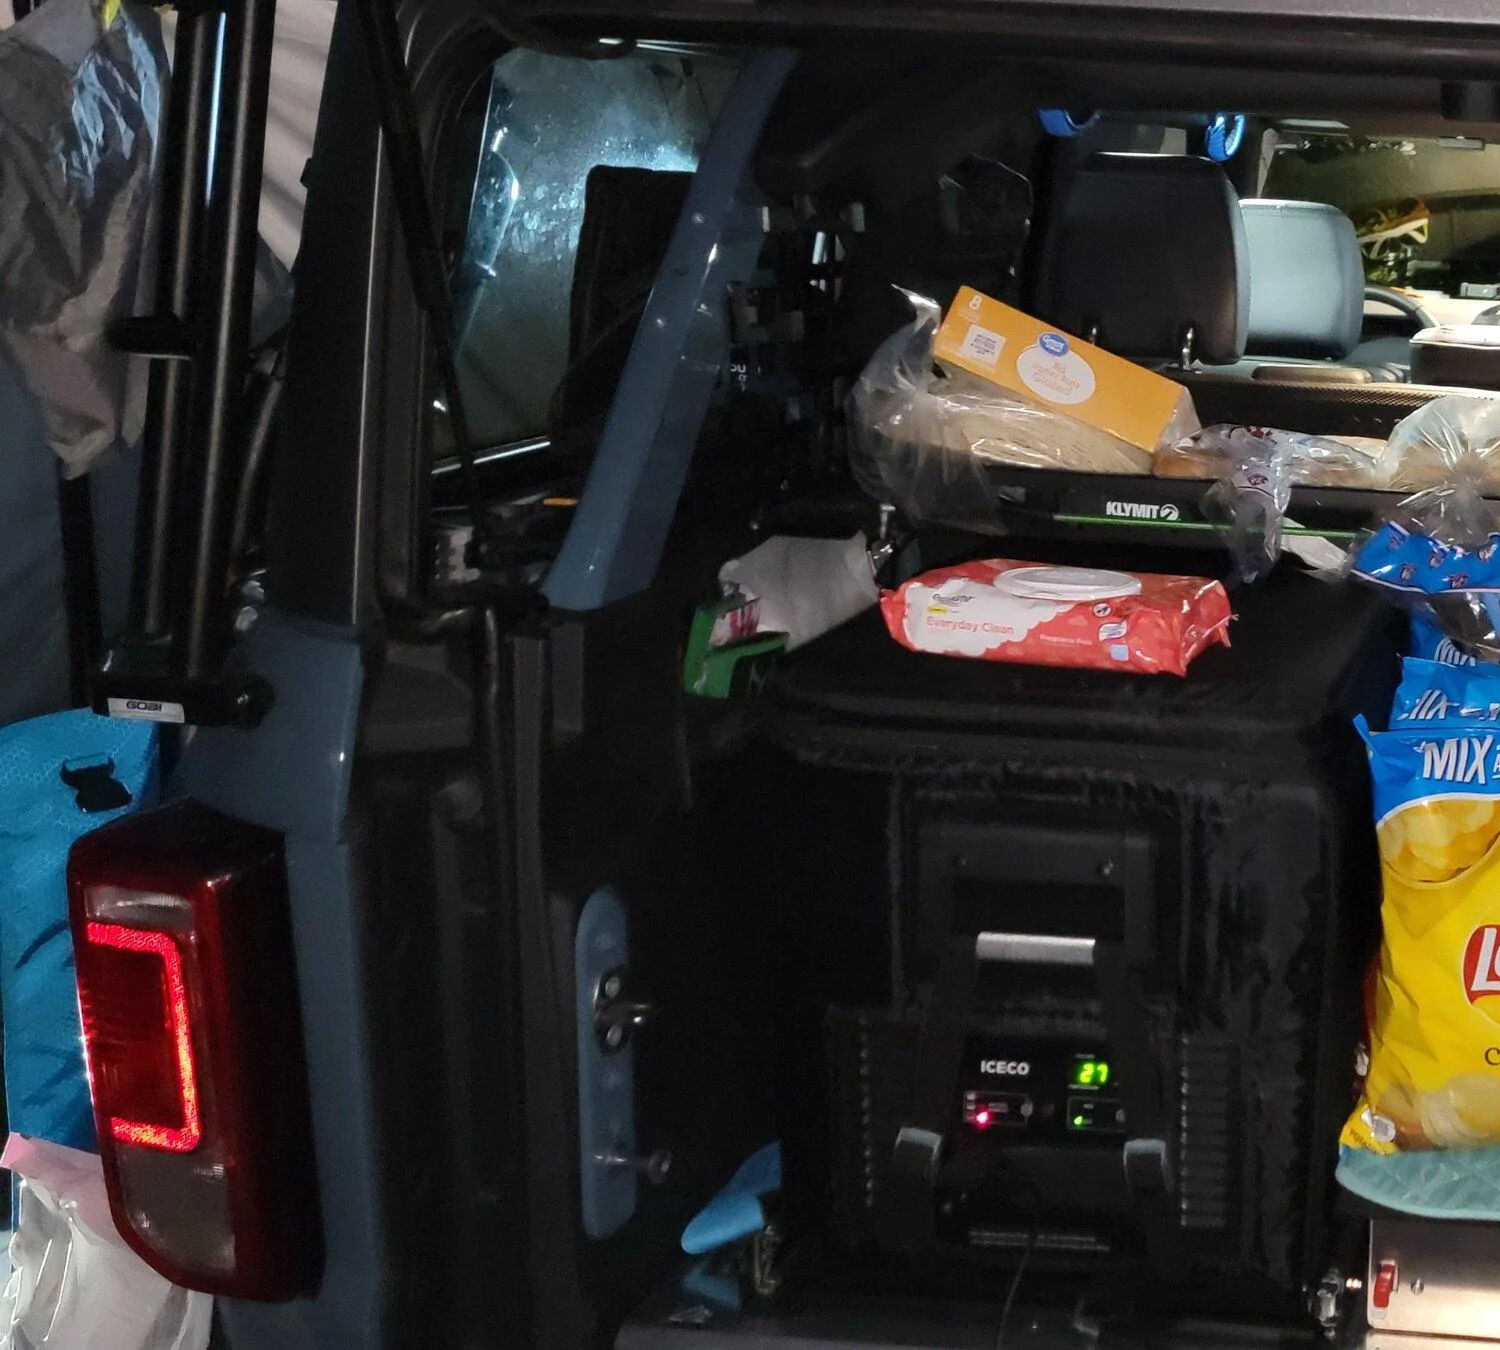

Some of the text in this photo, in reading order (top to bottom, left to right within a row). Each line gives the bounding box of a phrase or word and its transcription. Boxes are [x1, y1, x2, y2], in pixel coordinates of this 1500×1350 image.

[969, 295, 982, 310] 8
[1106, 501, 1160, 519] KLYMIT
[926, 617, 1014, 635] Everyday Clean
[1422, 735, 1493, 784] MIX
[980, 1060, 1030, 1076] ICECO
